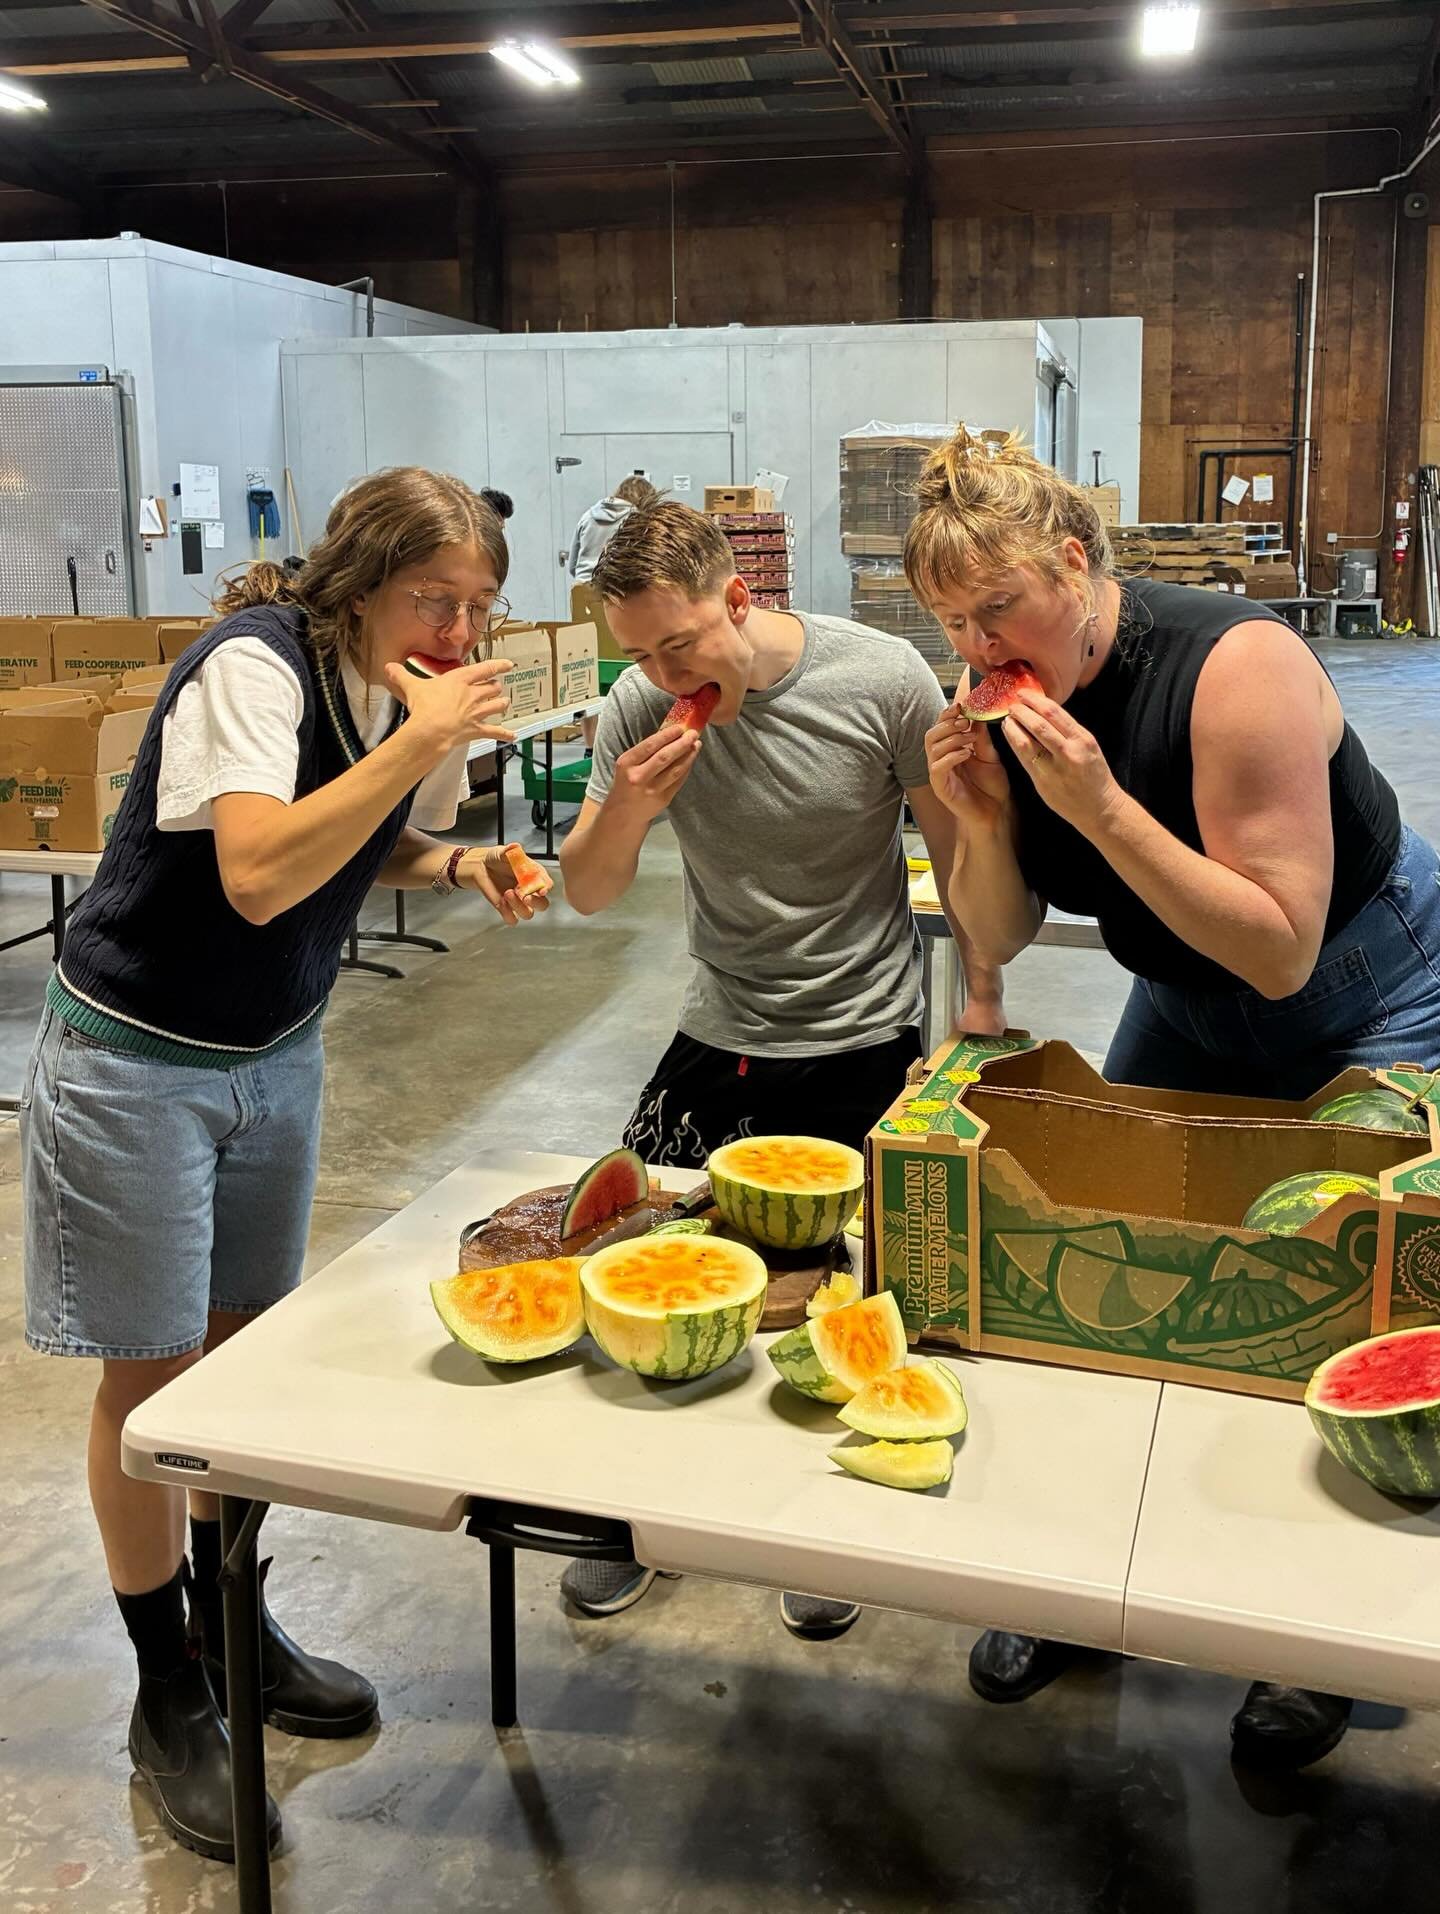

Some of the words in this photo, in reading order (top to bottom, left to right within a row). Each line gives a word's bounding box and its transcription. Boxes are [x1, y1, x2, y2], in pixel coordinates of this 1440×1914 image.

[0, 658, 38, 668] ERATIVE
[64, 660, 84, 669] FEED
[85, 660, 146, 670] COOPERATIVE
[504, 675, 514, 684] FEED
[515, 667, 548, 682] COOPERATIVE
[20, 786, 44, 797] FEED
[44, 786, 62, 798] BIN
[904, 1160, 925, 1210] MINI
[928, 1161, 949, 1317] WATERMELONS
[902, 1210, 925, 1315] Premium
[162, 1455, 204, 1468] LIFETIME
